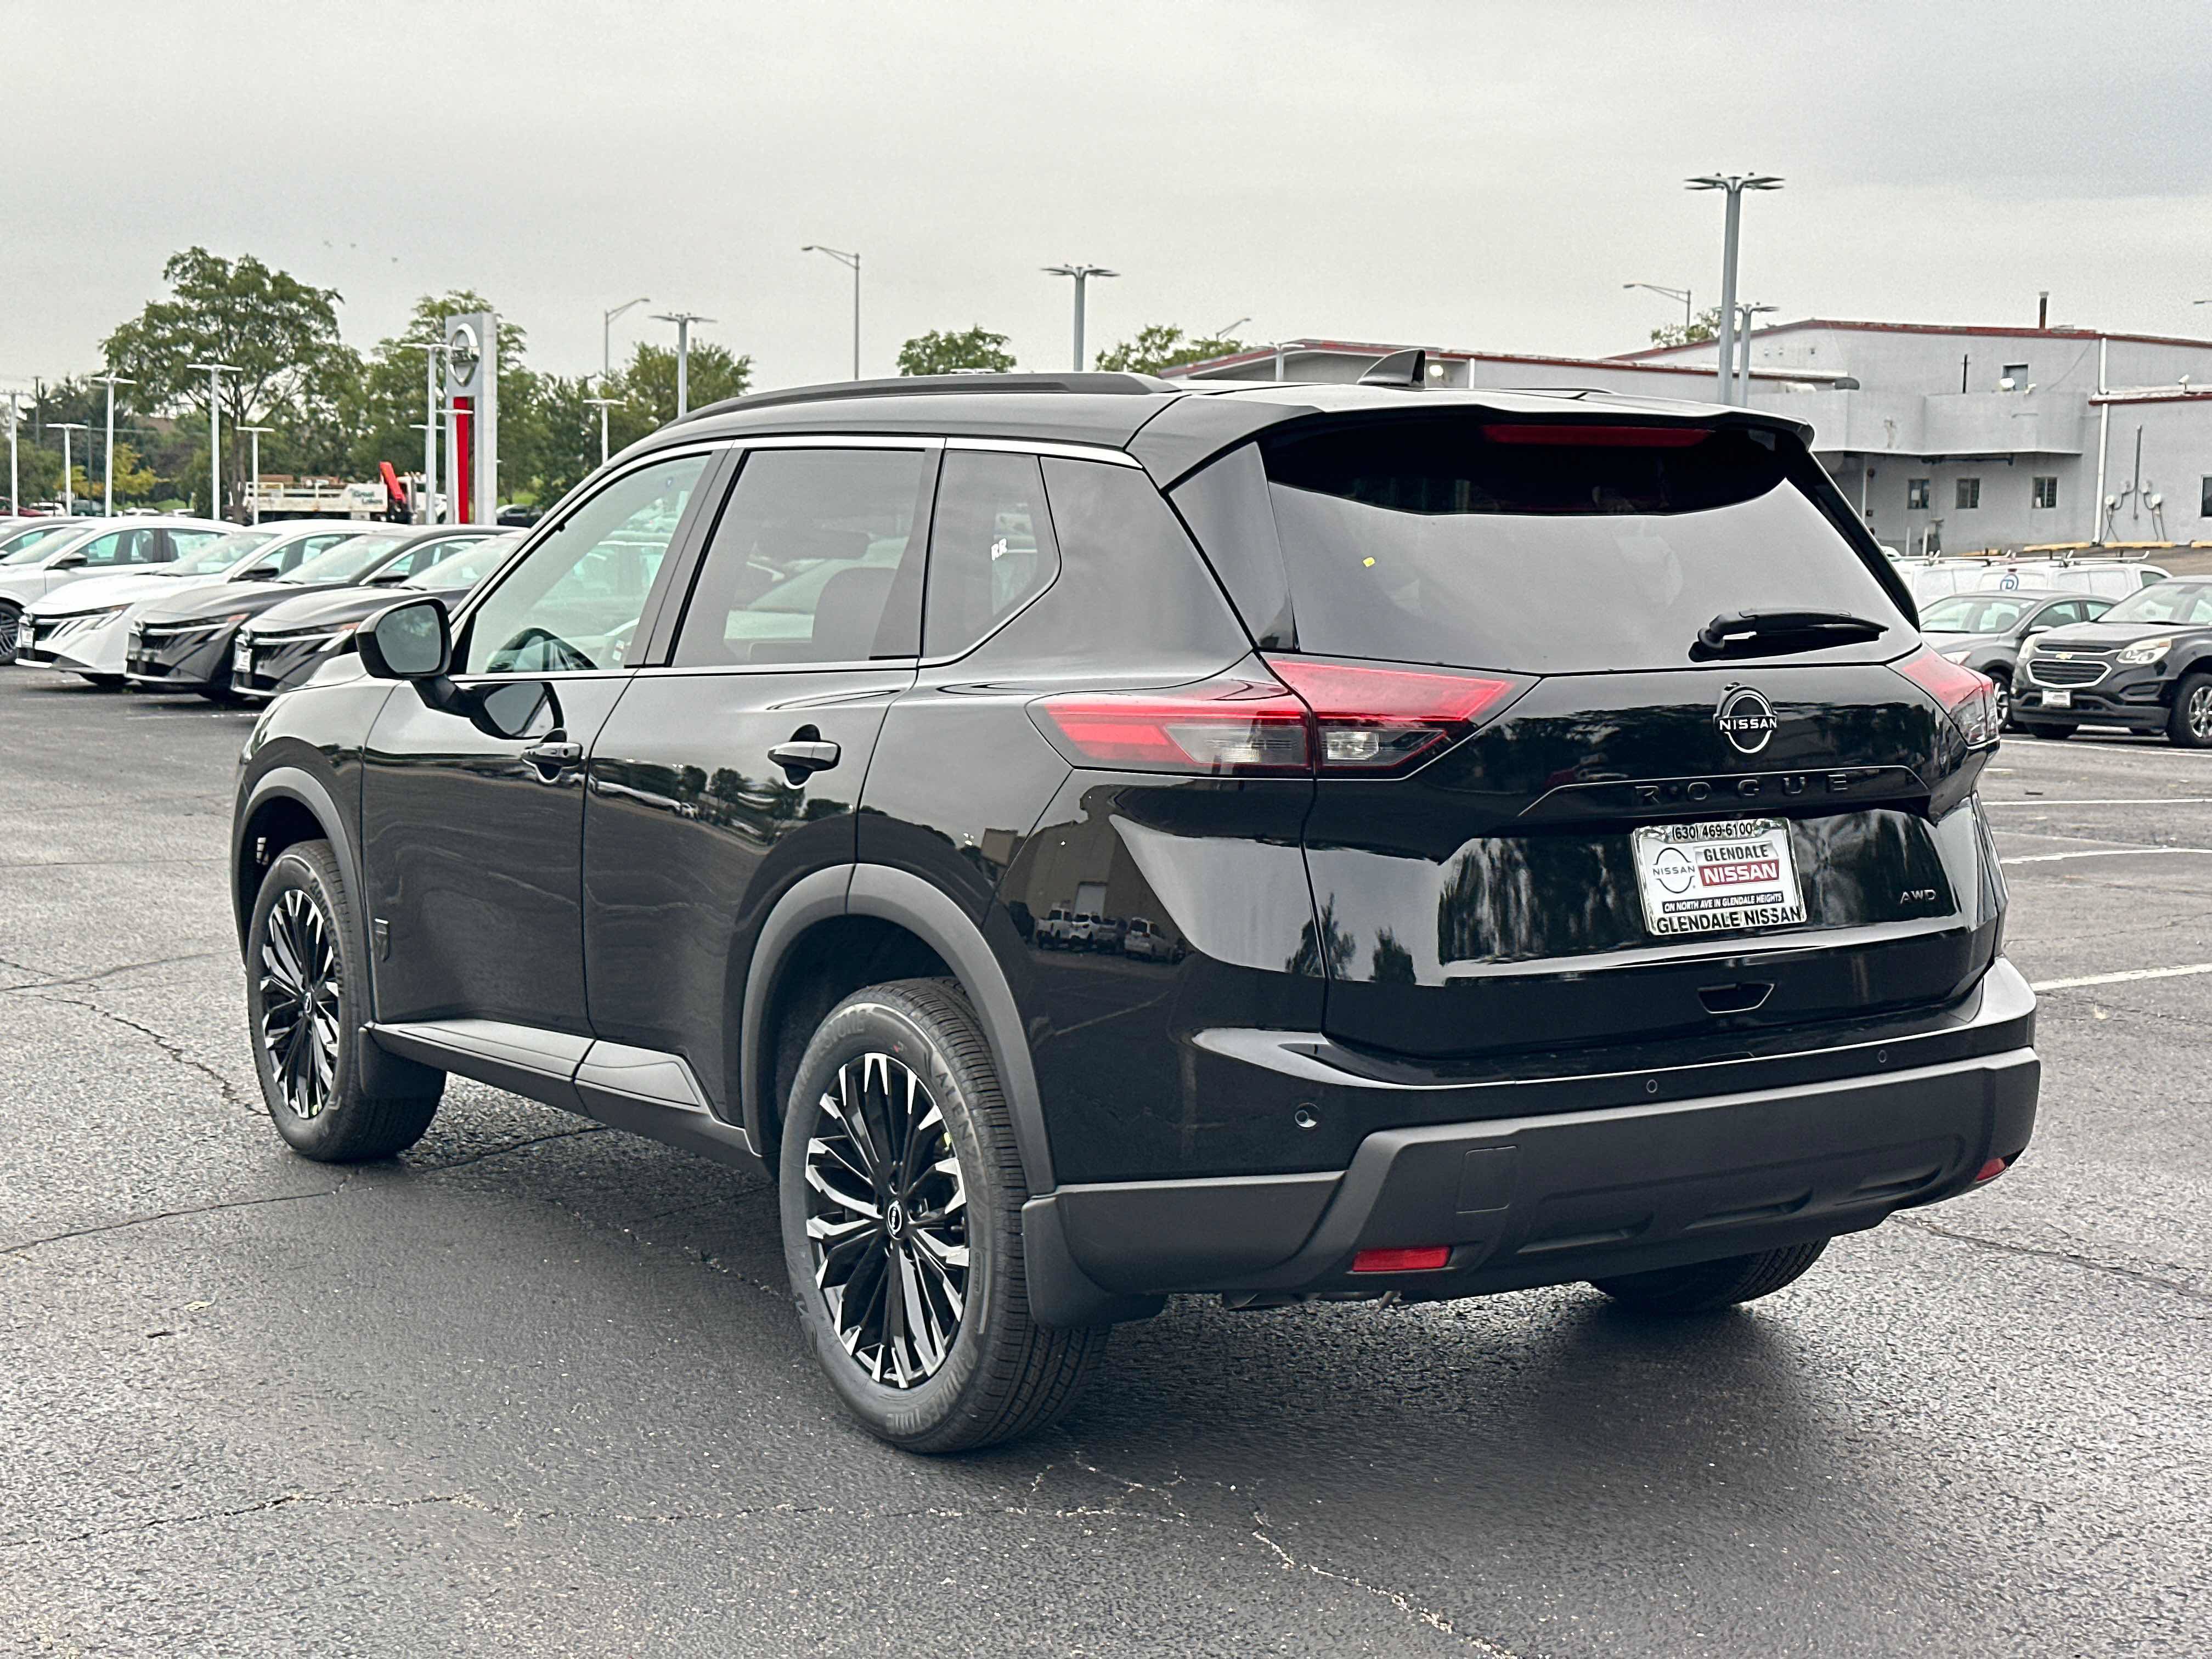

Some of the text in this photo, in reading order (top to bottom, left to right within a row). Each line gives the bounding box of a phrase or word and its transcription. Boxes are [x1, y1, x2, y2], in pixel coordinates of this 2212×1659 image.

[1719, 718, 1778, 731] NISSAN
[1634, 774, 1848, 804] ROGUE
[1672, 822, 1753, 840] (630) 469-6100
[1704, 844, 1769, 862] GLENDALE
[1652, 864, 1695, 876] NISSAN
[1703, 862, 1778, 884] NISSAN
[1664, 893, 1782, 912] ON NORTH AVE IN GLENDALE HEIGHTS
[1900, 889, 1937, 904] AWD
[1656, 906, 1802, 934] GLENDALE NISSAN
